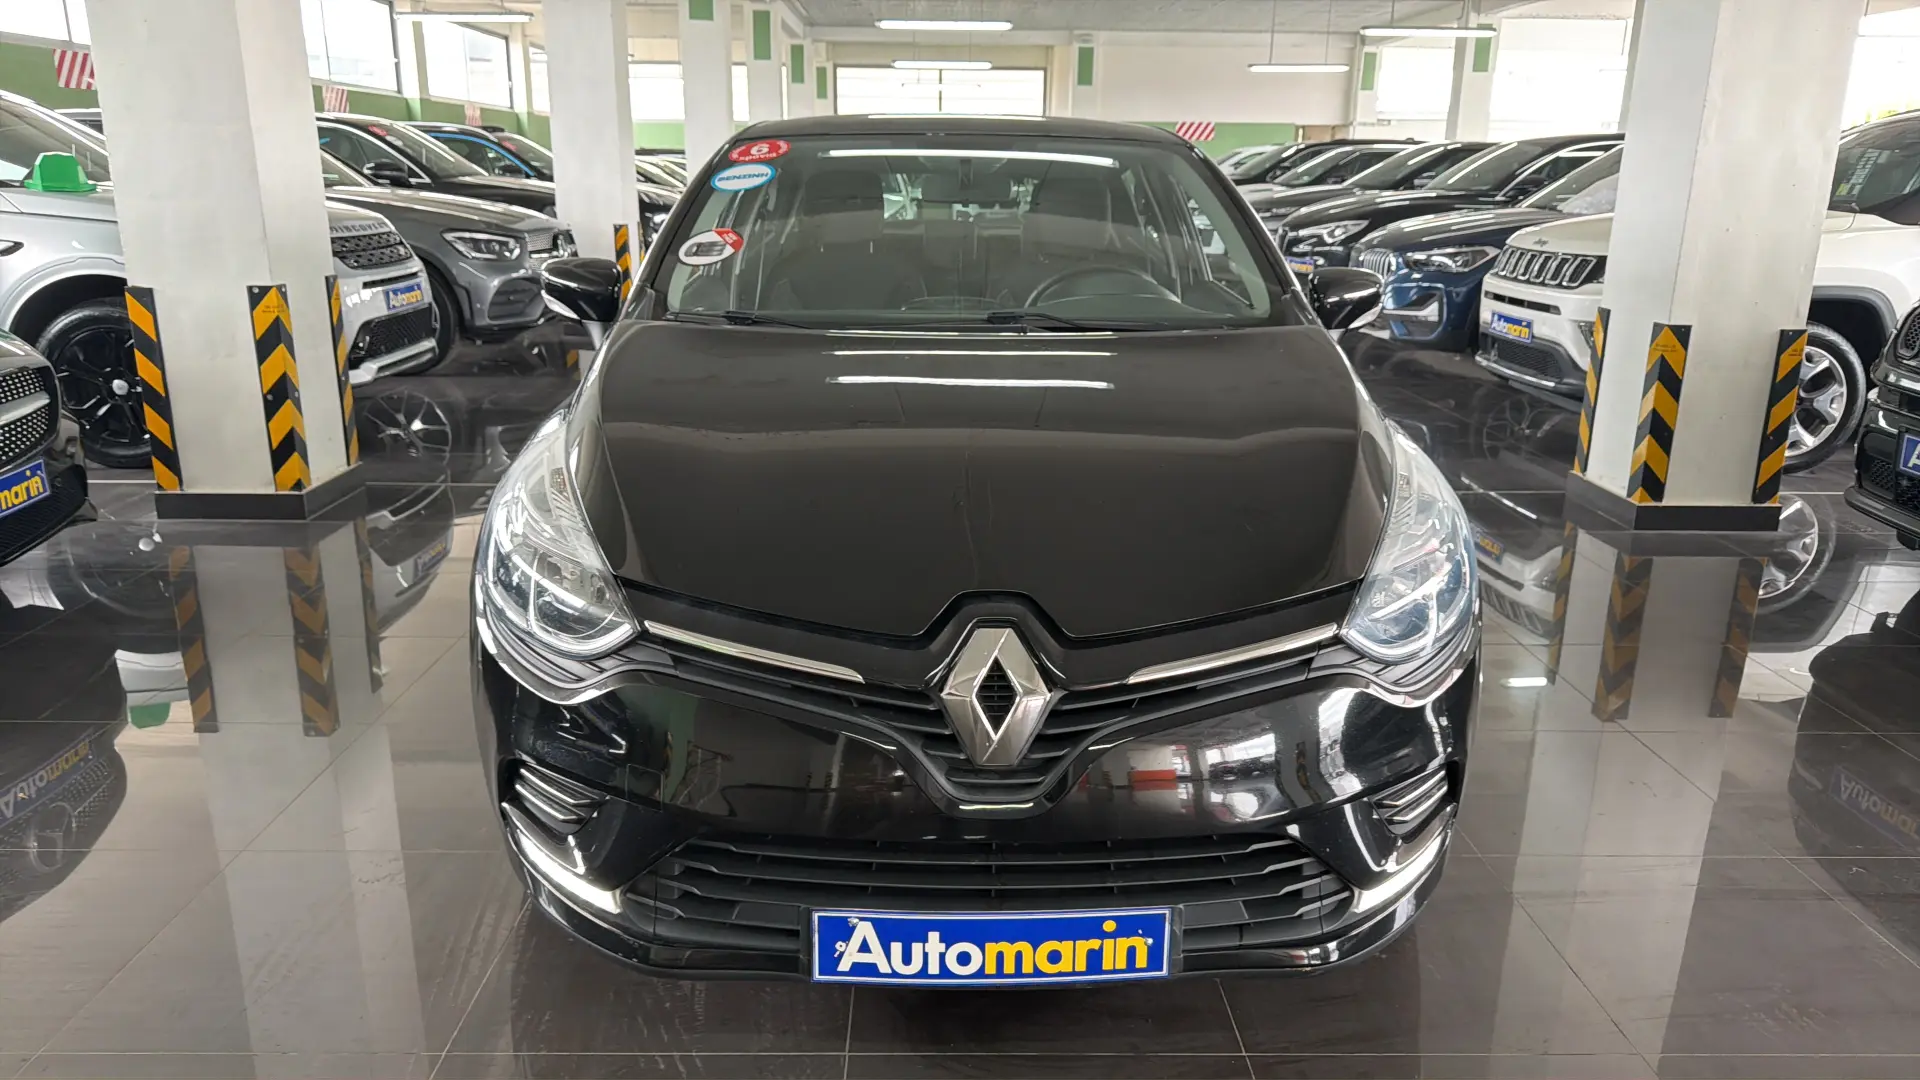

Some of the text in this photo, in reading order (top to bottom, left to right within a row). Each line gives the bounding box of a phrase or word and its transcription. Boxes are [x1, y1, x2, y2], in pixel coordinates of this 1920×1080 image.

[750, 143, 770, 155] 6
[1491, 314, 1530, 339] Automarin
[836, 920, 1149, 976] Automarin
